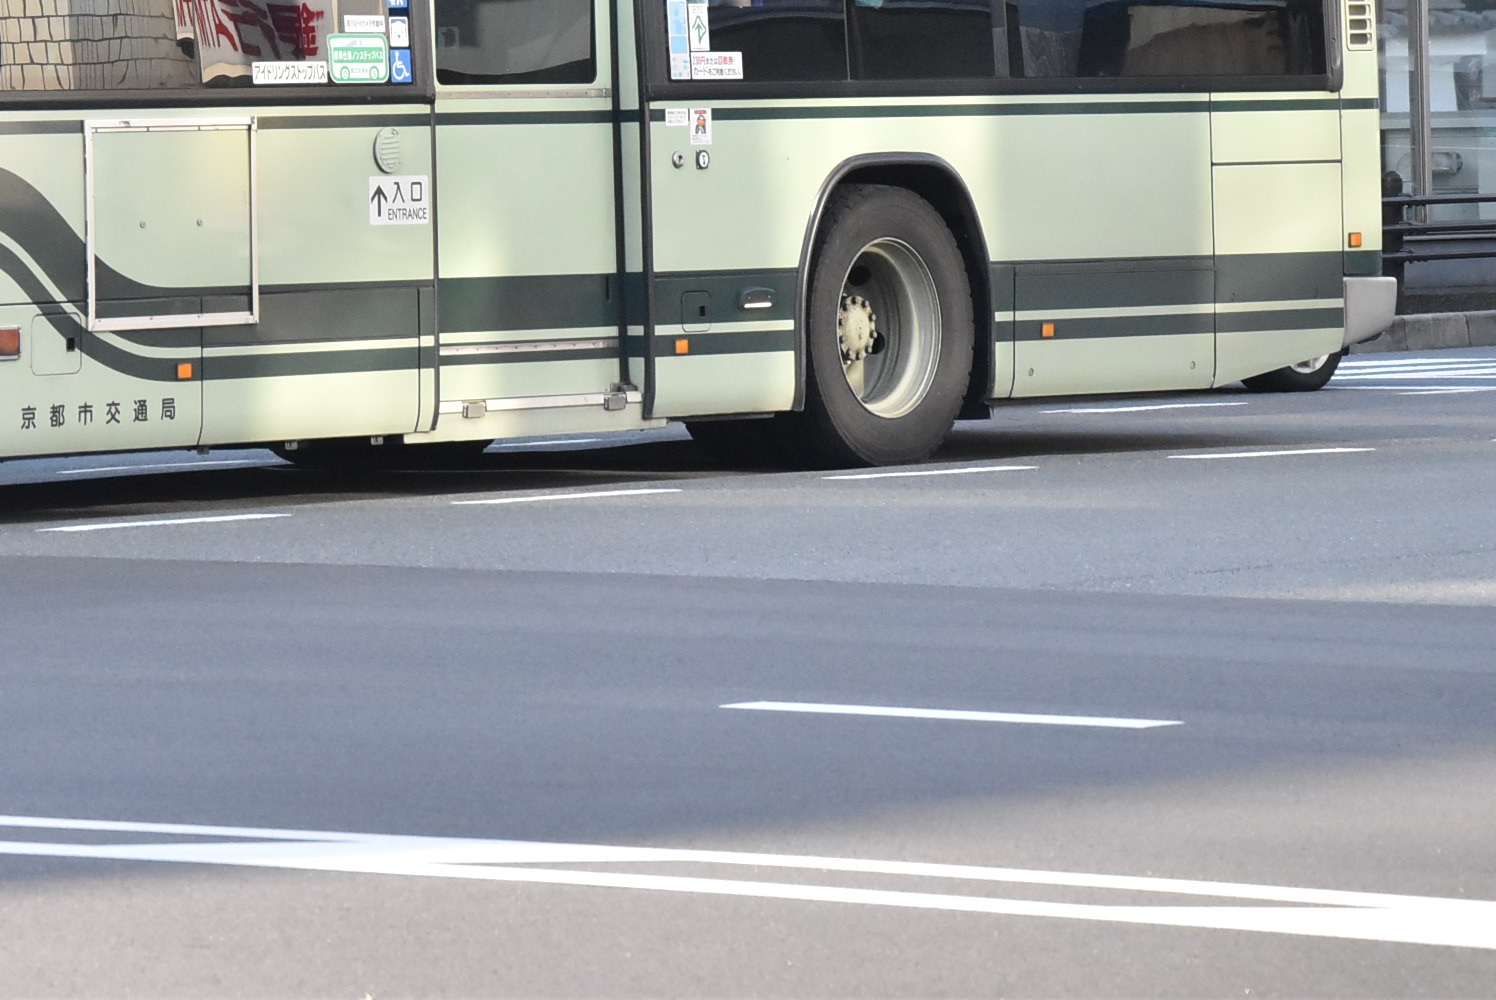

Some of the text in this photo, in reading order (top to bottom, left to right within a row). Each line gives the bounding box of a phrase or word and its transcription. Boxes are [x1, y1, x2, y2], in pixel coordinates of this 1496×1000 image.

[254, 64, 326, 81] アイドリングストップバス
[392, 181, 422, 204] 入口
[388, 207, 427, 220] ENTRANCE
[20, 397, 176, 430] 京都市交通局
